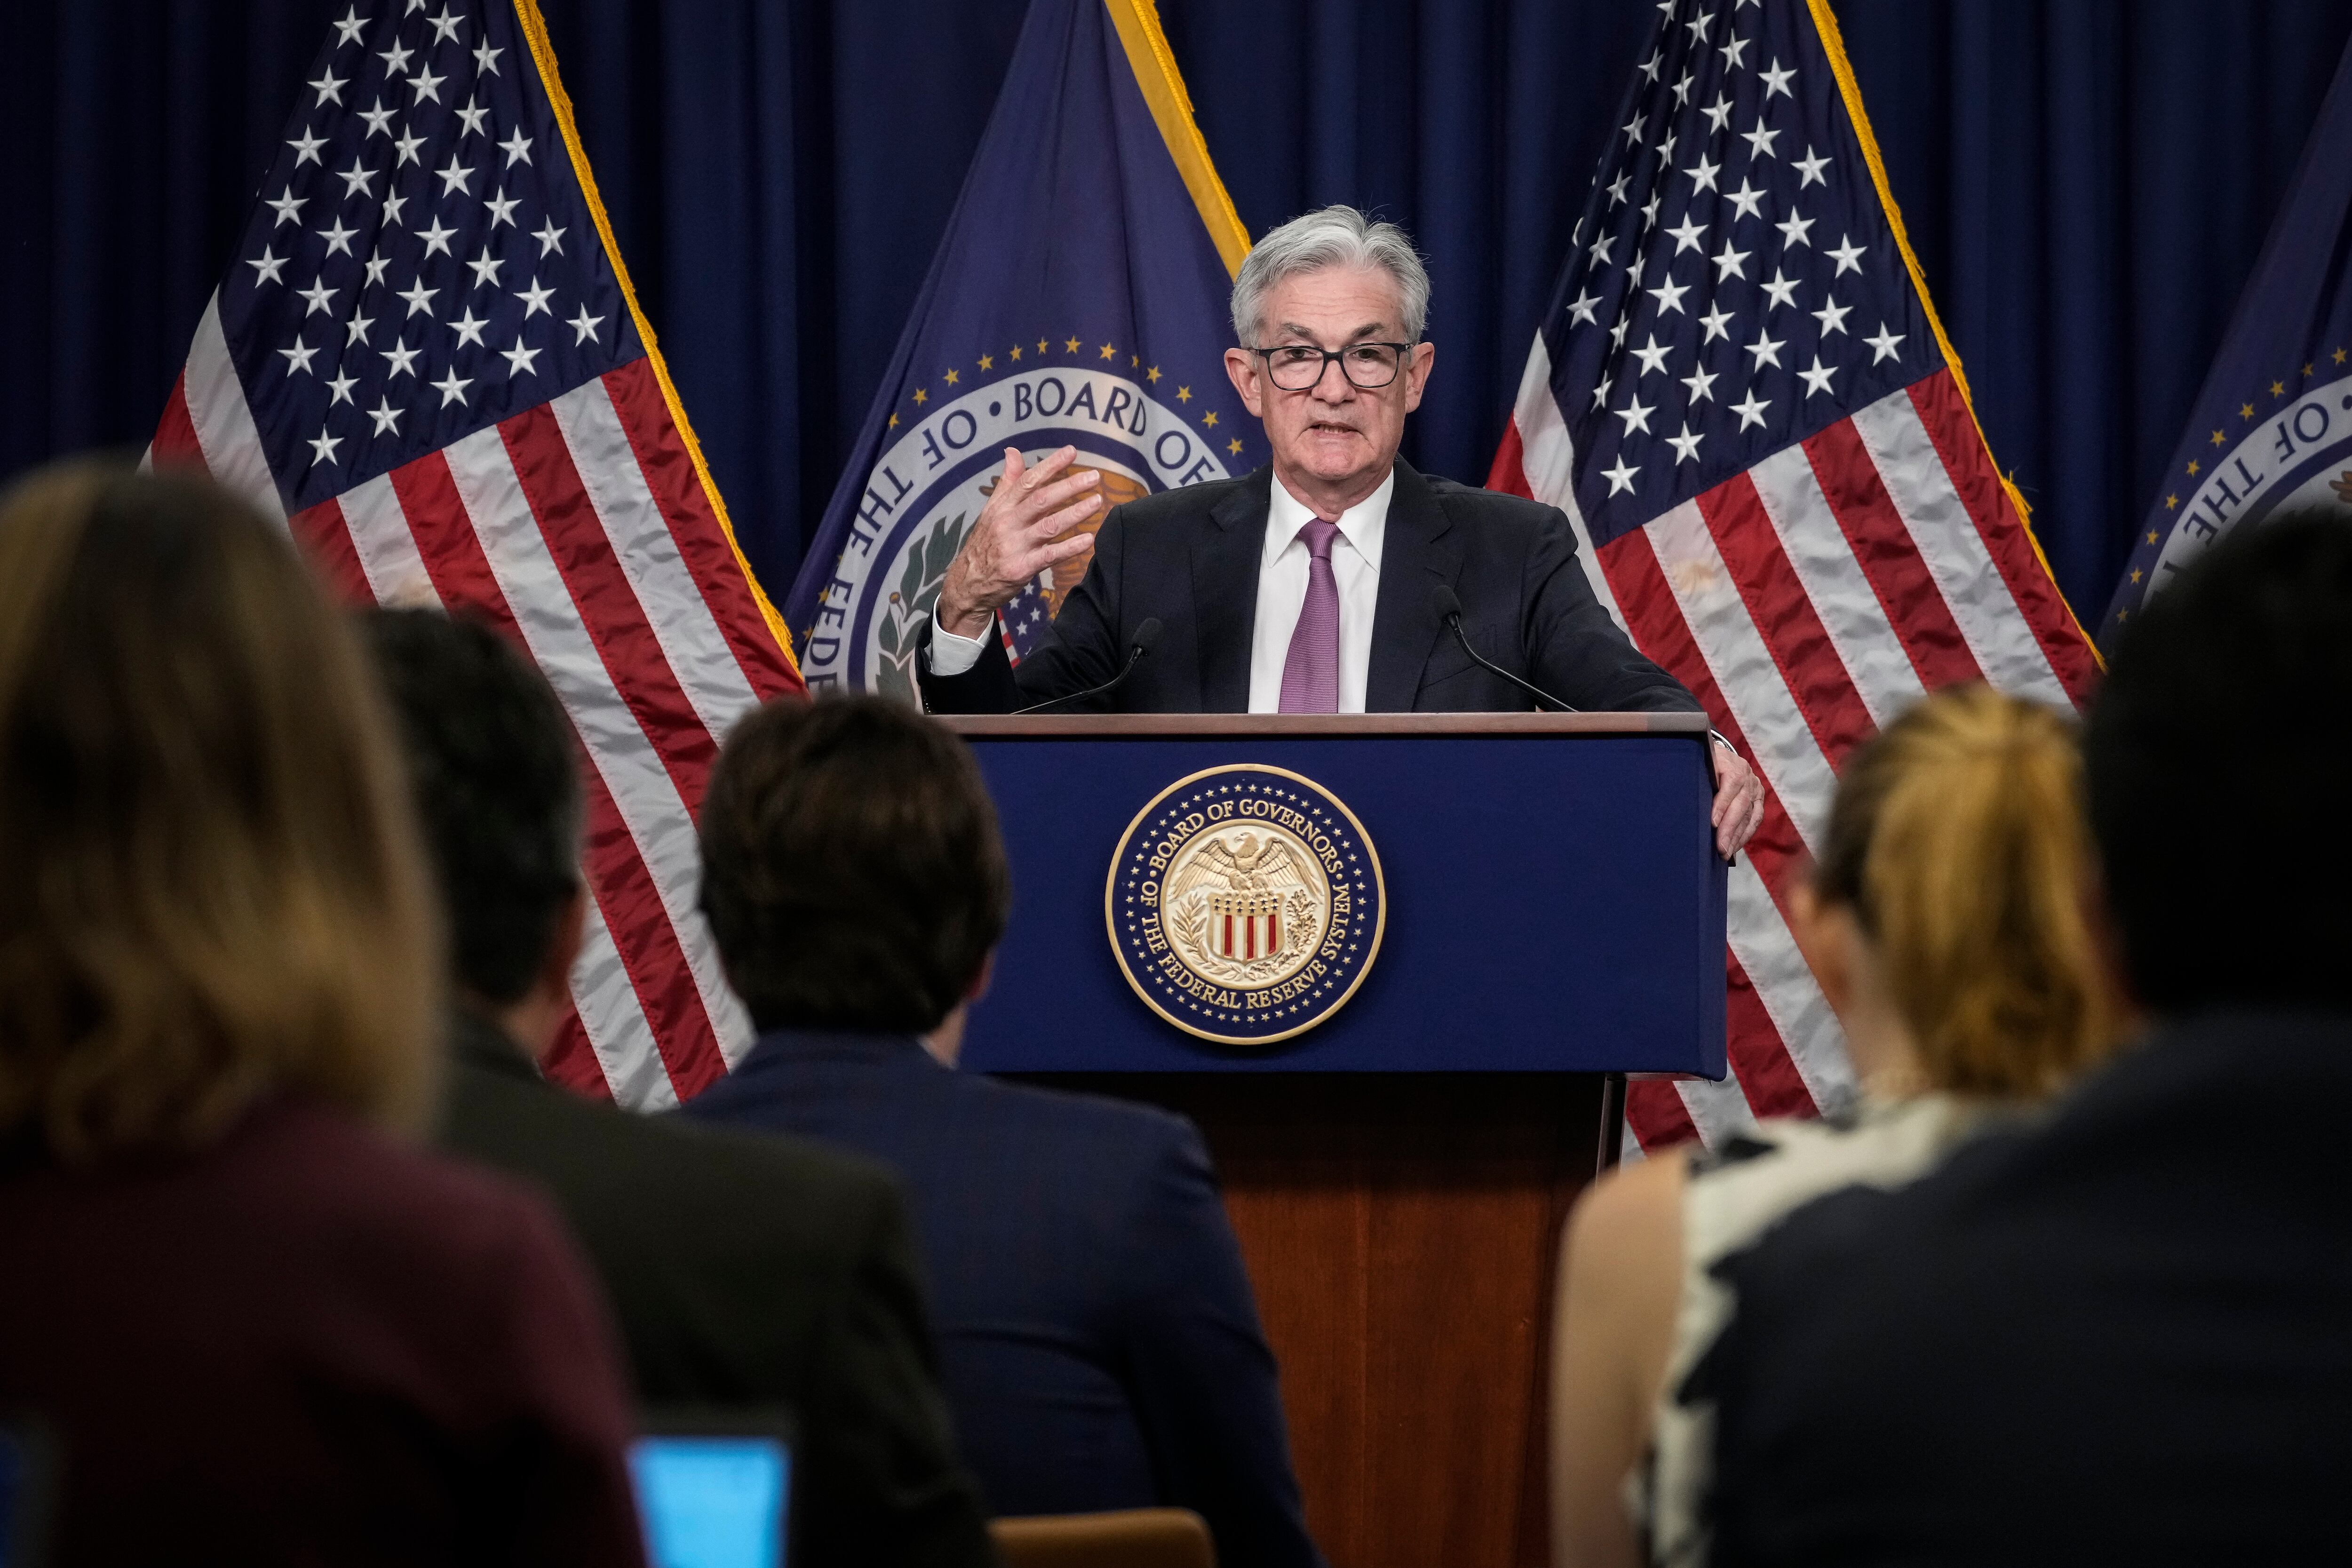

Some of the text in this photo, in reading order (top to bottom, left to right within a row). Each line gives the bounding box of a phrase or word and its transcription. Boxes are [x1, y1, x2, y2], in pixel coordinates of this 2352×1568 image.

[922, 409, 977, 470] OF
[1014, 377, 1216, 487] BOARD OF
[2183, 402, 2329, 547] OF THE
[850, 466, 914, 558] THE
[1149, 799, 1344, 874] BOARD OF GOVERNORS
[1140, 881, 1351, 1009] OF THE FEDERAL RESERVE SYSTEM
